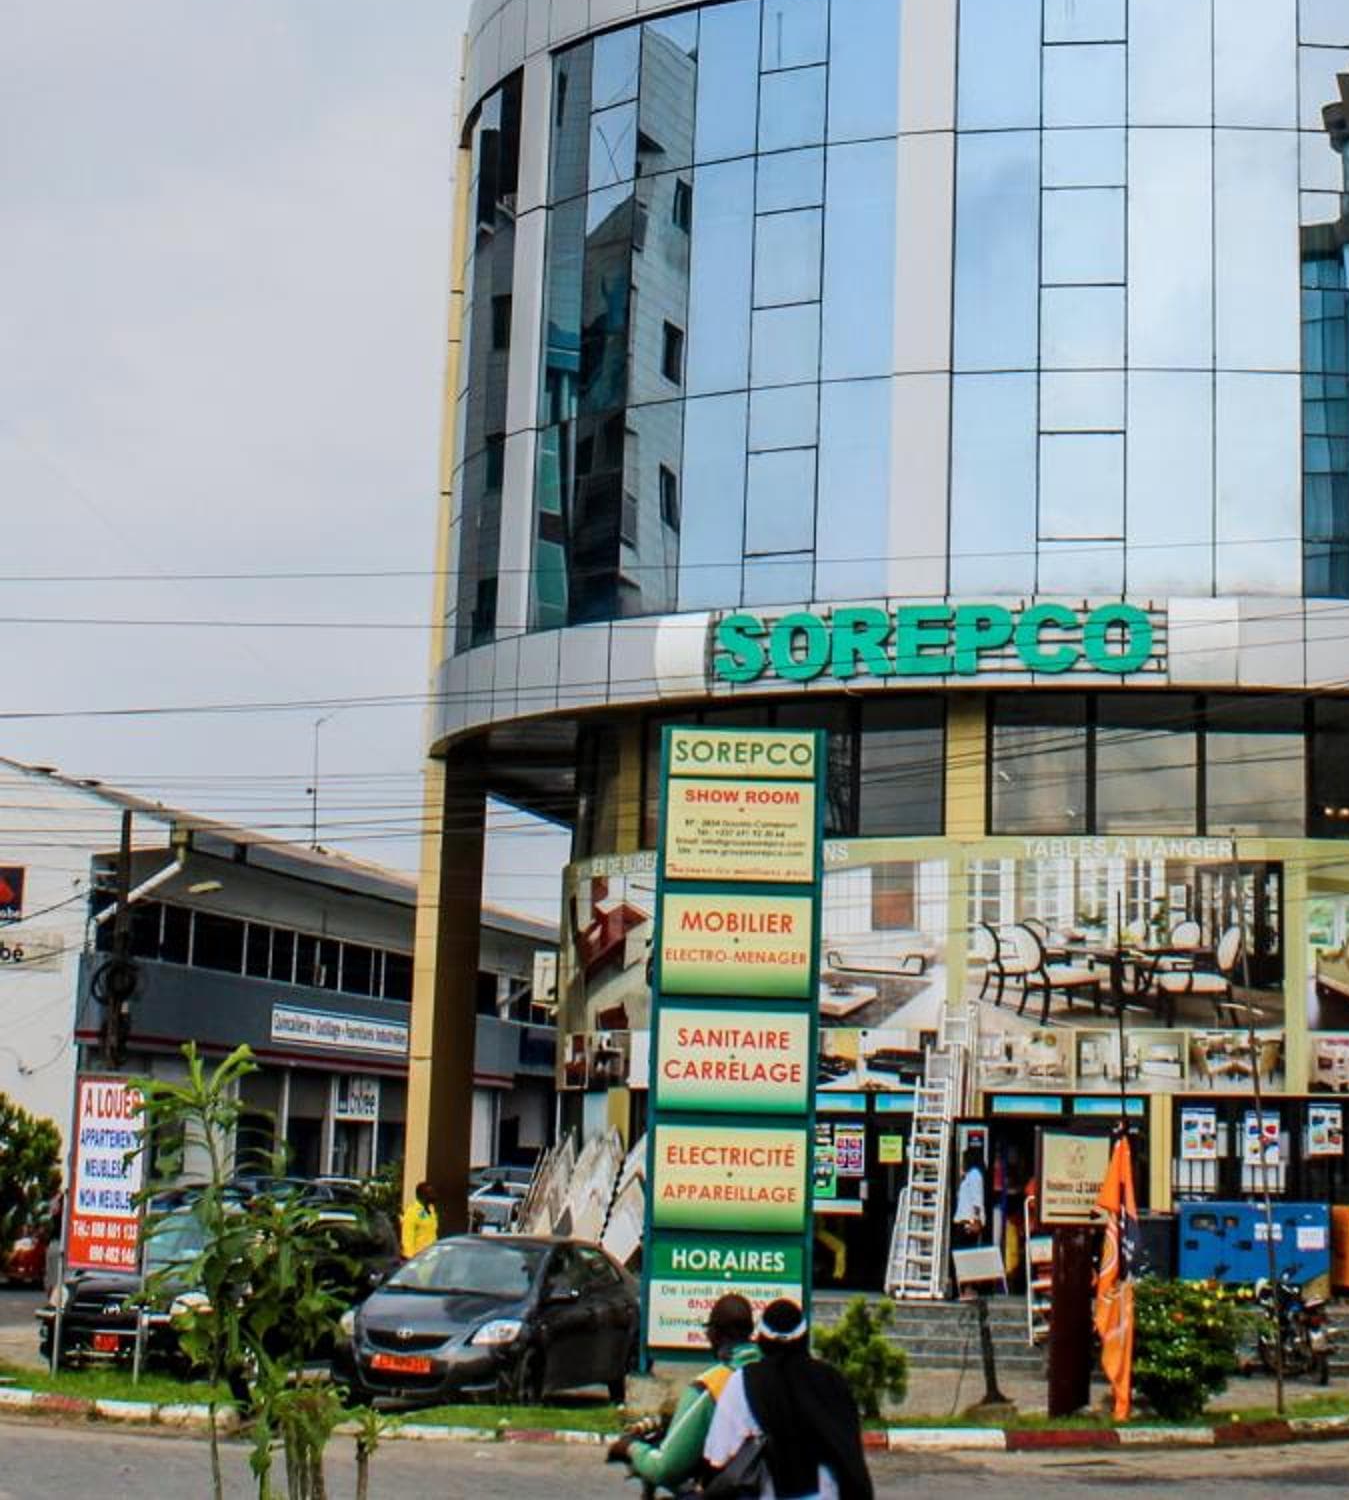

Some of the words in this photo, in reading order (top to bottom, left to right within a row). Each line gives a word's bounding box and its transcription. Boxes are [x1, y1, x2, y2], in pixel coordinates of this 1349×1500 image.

[714, 604, 1153, 682] SOREPCO
[675, 739, 812, 766] SOREPCO
[685, 788, 739, 803] SHOW
[745, 790, 800, 804] ROOM
[1023, 839, 1107, 859] TABLES
[1136, 839, 1232, 858] MANGER
[681, 911, 793, 933] MOBILIER
[677, 1027, 790, 1050] SANITAIRE
[664, 1060, 801, 1082] CARRELAGE
[663, 1183, 797, 1203] APPAREILLAGE
[672, 1248, 785, 1272] HORAIRES
